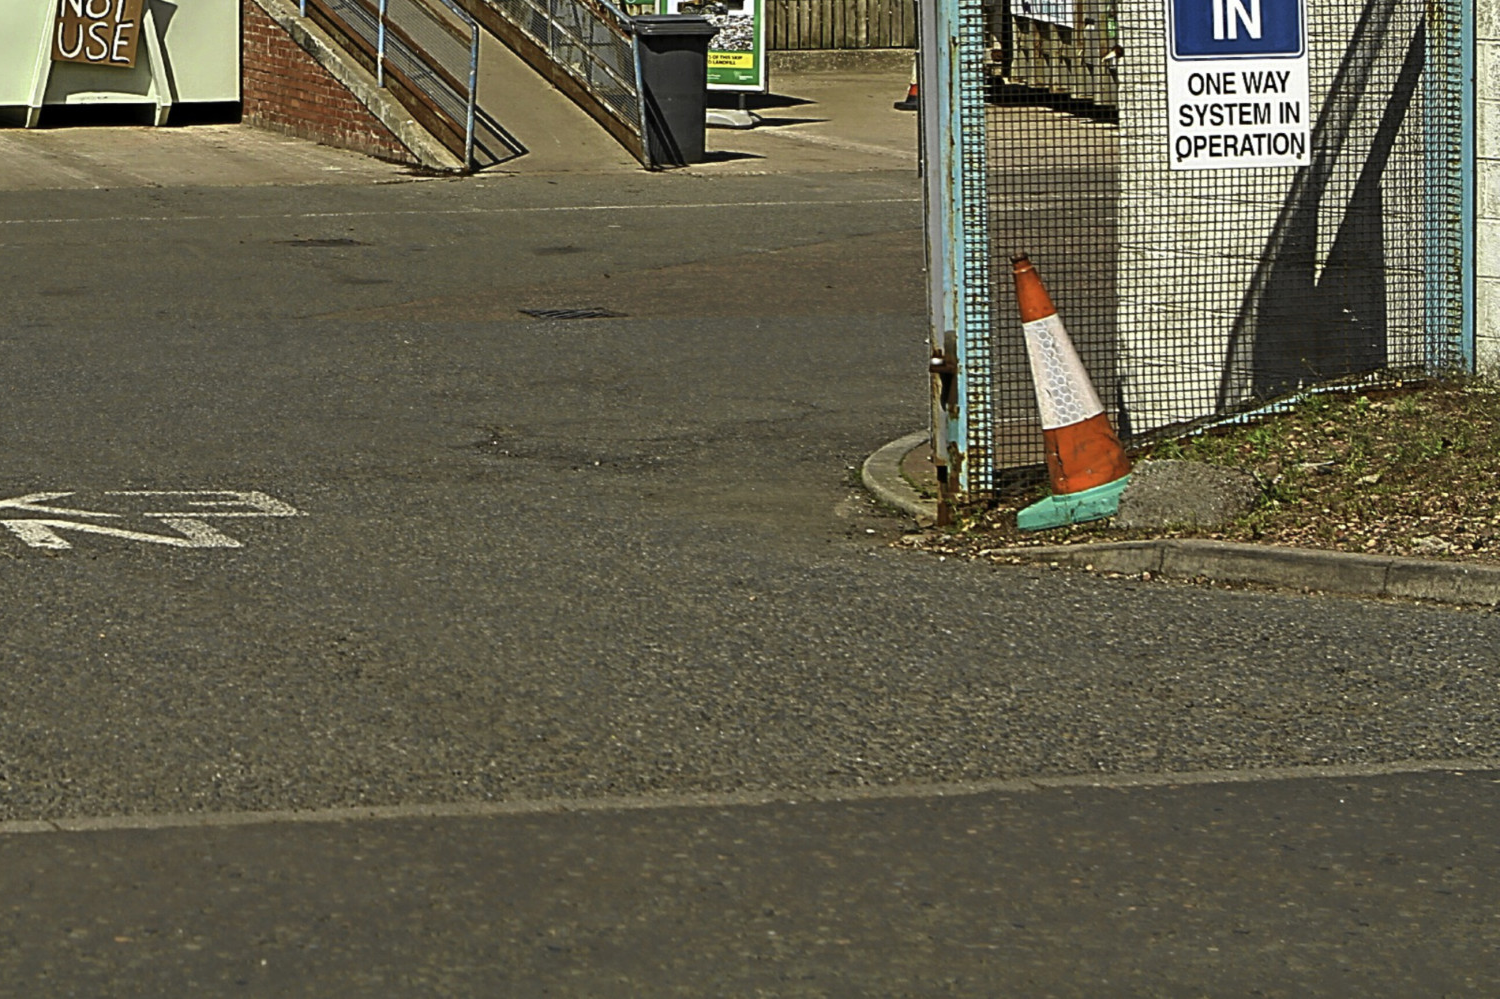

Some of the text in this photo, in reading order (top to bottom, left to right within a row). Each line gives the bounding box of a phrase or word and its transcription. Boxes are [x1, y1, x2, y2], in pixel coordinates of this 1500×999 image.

[58, 21, 134, 62] USE
[1188, 71, 1290, 96] ONE WAY
[1179, 101, 1300, 127] SYSTEM IN
[1175, 132, 1306, 158] OPERATION
